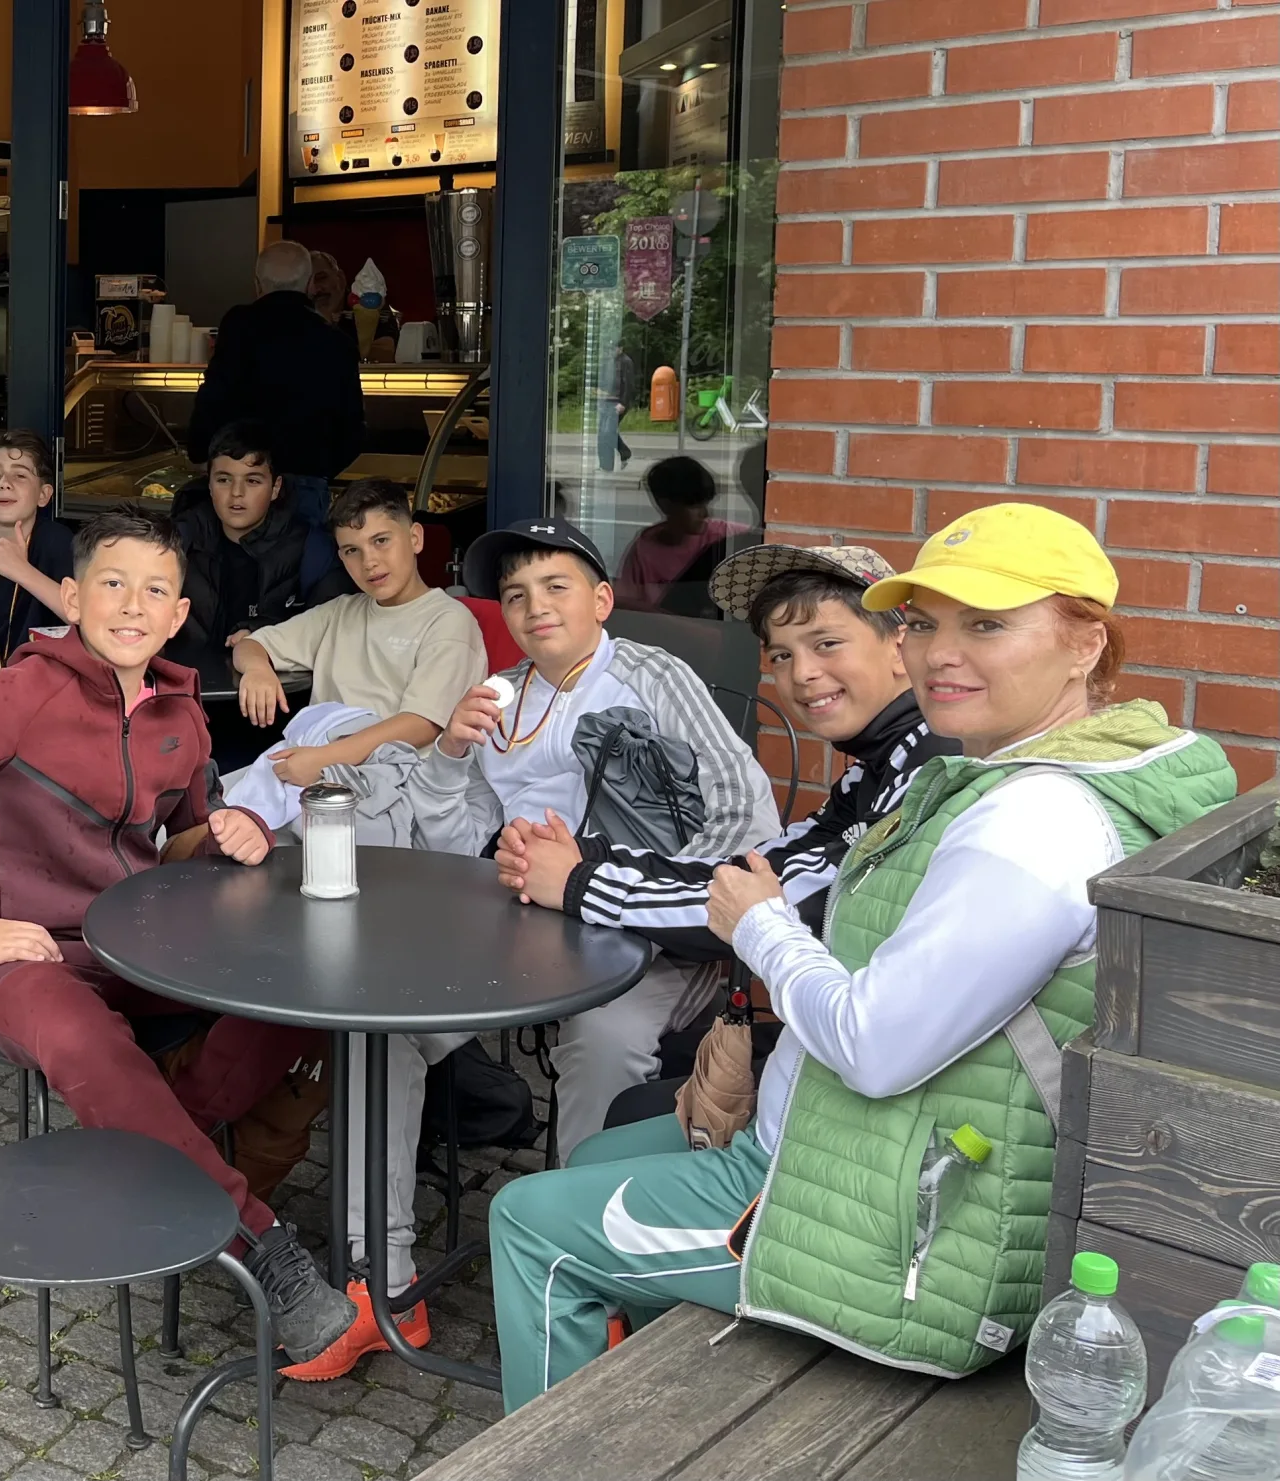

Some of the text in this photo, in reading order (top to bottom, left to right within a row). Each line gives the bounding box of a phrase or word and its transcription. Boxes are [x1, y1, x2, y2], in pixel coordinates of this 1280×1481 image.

[426, 5, 450, 15] BANANE
[362, 13, 401, 25] FRÜCHTE-MIX
[303, 24, 327, 34] JOGHURT
[424, 58, 457, 69] SPAGHETTI
[360, 67, 394, 77] HASELNUSS
[302, 75, 333, 85] HEIDELBEER
[629, 224, 642, 232] Top
